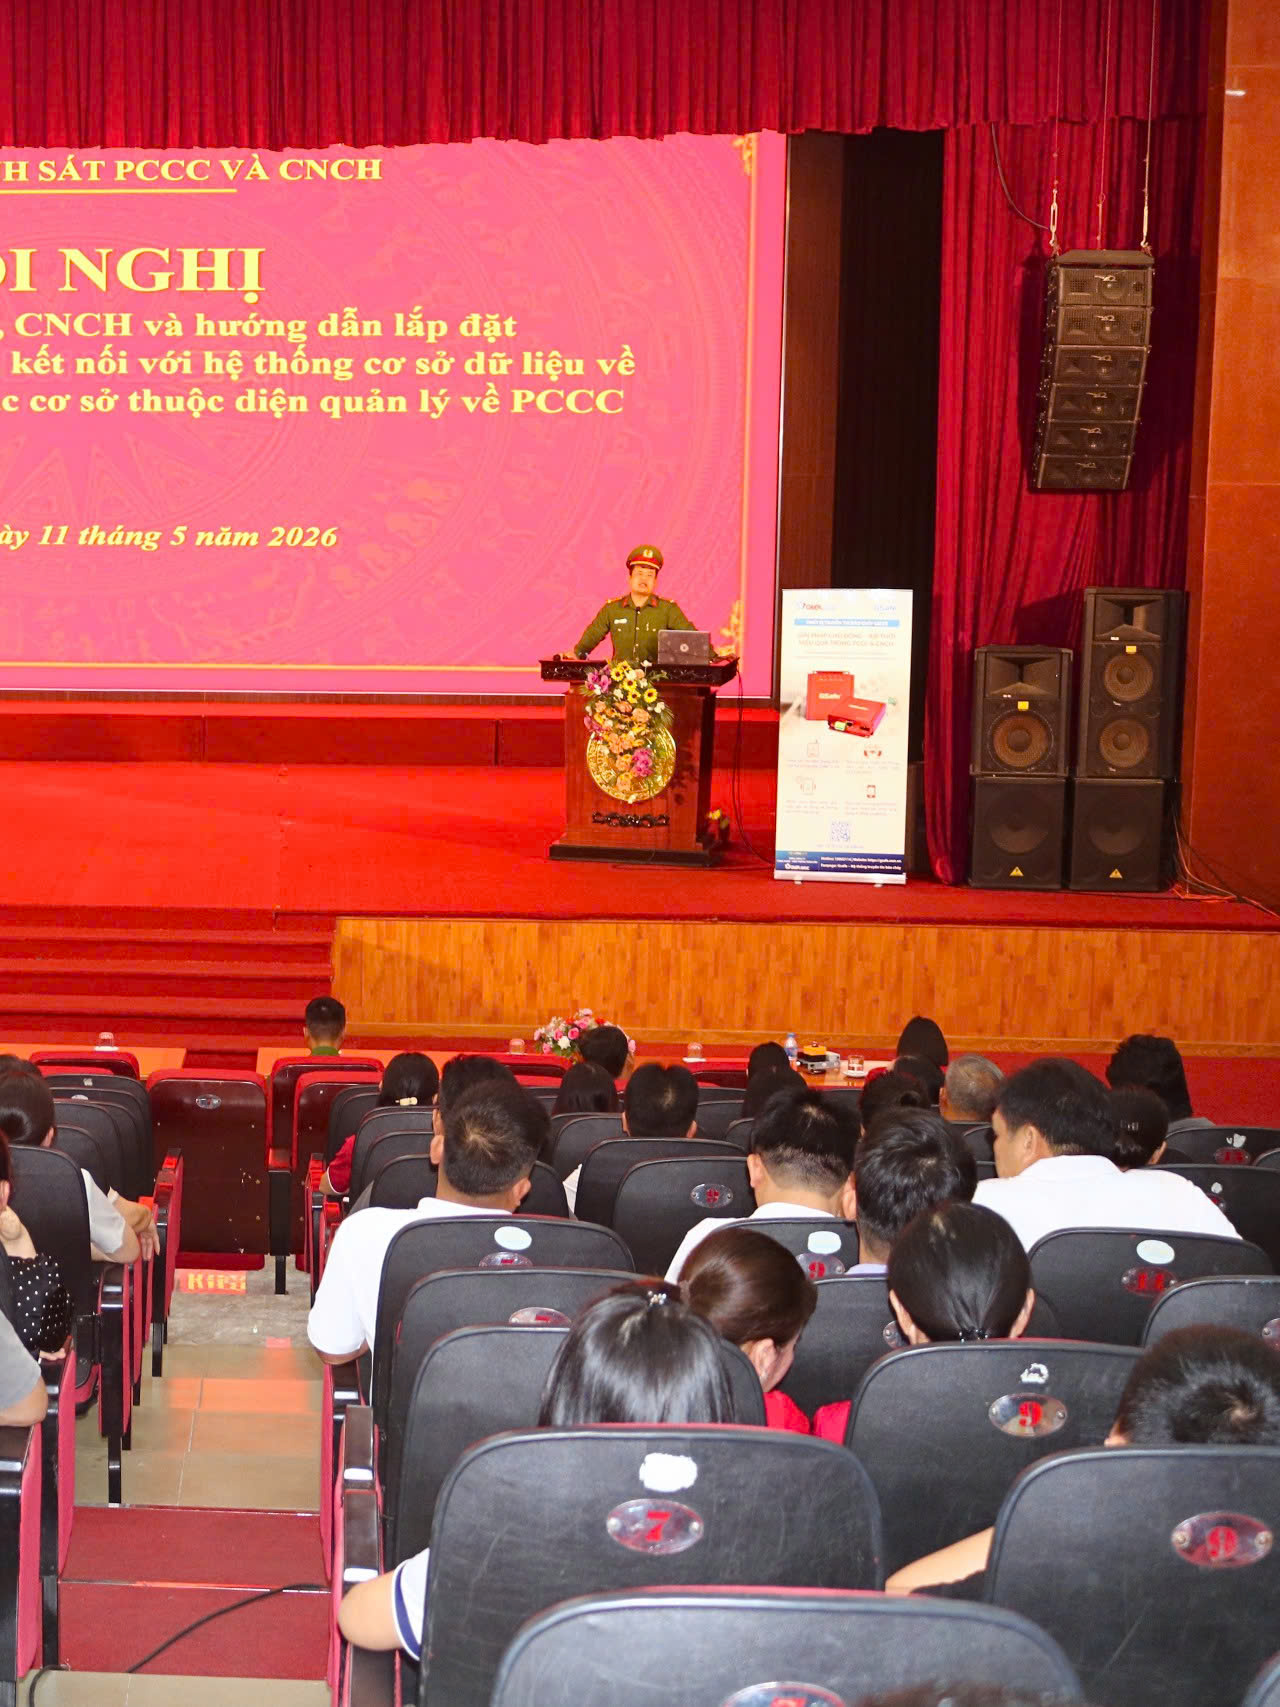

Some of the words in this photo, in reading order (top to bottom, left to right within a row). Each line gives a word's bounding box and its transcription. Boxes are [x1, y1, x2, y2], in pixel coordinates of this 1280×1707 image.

[38, 154, 106, 182] SÁT
[115, 159, 211, 181] PCCC
[219, 153, 270, 181] VÀ
[279, 158, 382, 181] CNCH
[59, 247, 266, 304] NGHỊ
[14, 312, 133, 338] CNCH
[143, 312, 183, 337] và
[195, 312, 308, 345] hướng
[317, 307, 382, 337] dẫn
[394, 305, 449, 344] lắp
[459, 313, 517, 344] đặt
[11, 343, 65, 375] kết
[75, 343, 129, 375] nối
[138, 350, 193, 375] với
[203, 349, 244, 382] hệ
[253, 343, 354, 381] thống
[363, 356, 407, 375] cơ
[415, 351, 456, 375] sở
[463, 351, 514, 376] dữ
[522, 350, 585, 382] liệu
[596, 344, 636, 376] về
[29, 394, 71, 412] cơ
[79, 387, 119, 413] sở
[127, 387, 225, 419] thuộc
[235, 387, 309, 419] diện
[319, 388, 408, 419] quản
[419, 388, 451, 419] lý
[460, 382, 500, 414] về
[511, 389, 625, 414] PCCC
[39, 525, 69, 545] 11
[78, 524, 161, 552] tháng
[169, 525, 188, 546] 5
[195, 527, 259, 547] năm
[266, 526, 337, 547] 2026
[808, 1261, 825, 1279] 9
[1019, 1400, 1042, 1428] 9
[644, 1510, 670, 1541] 7
[1205, 1525, 1237, 1562] 9
